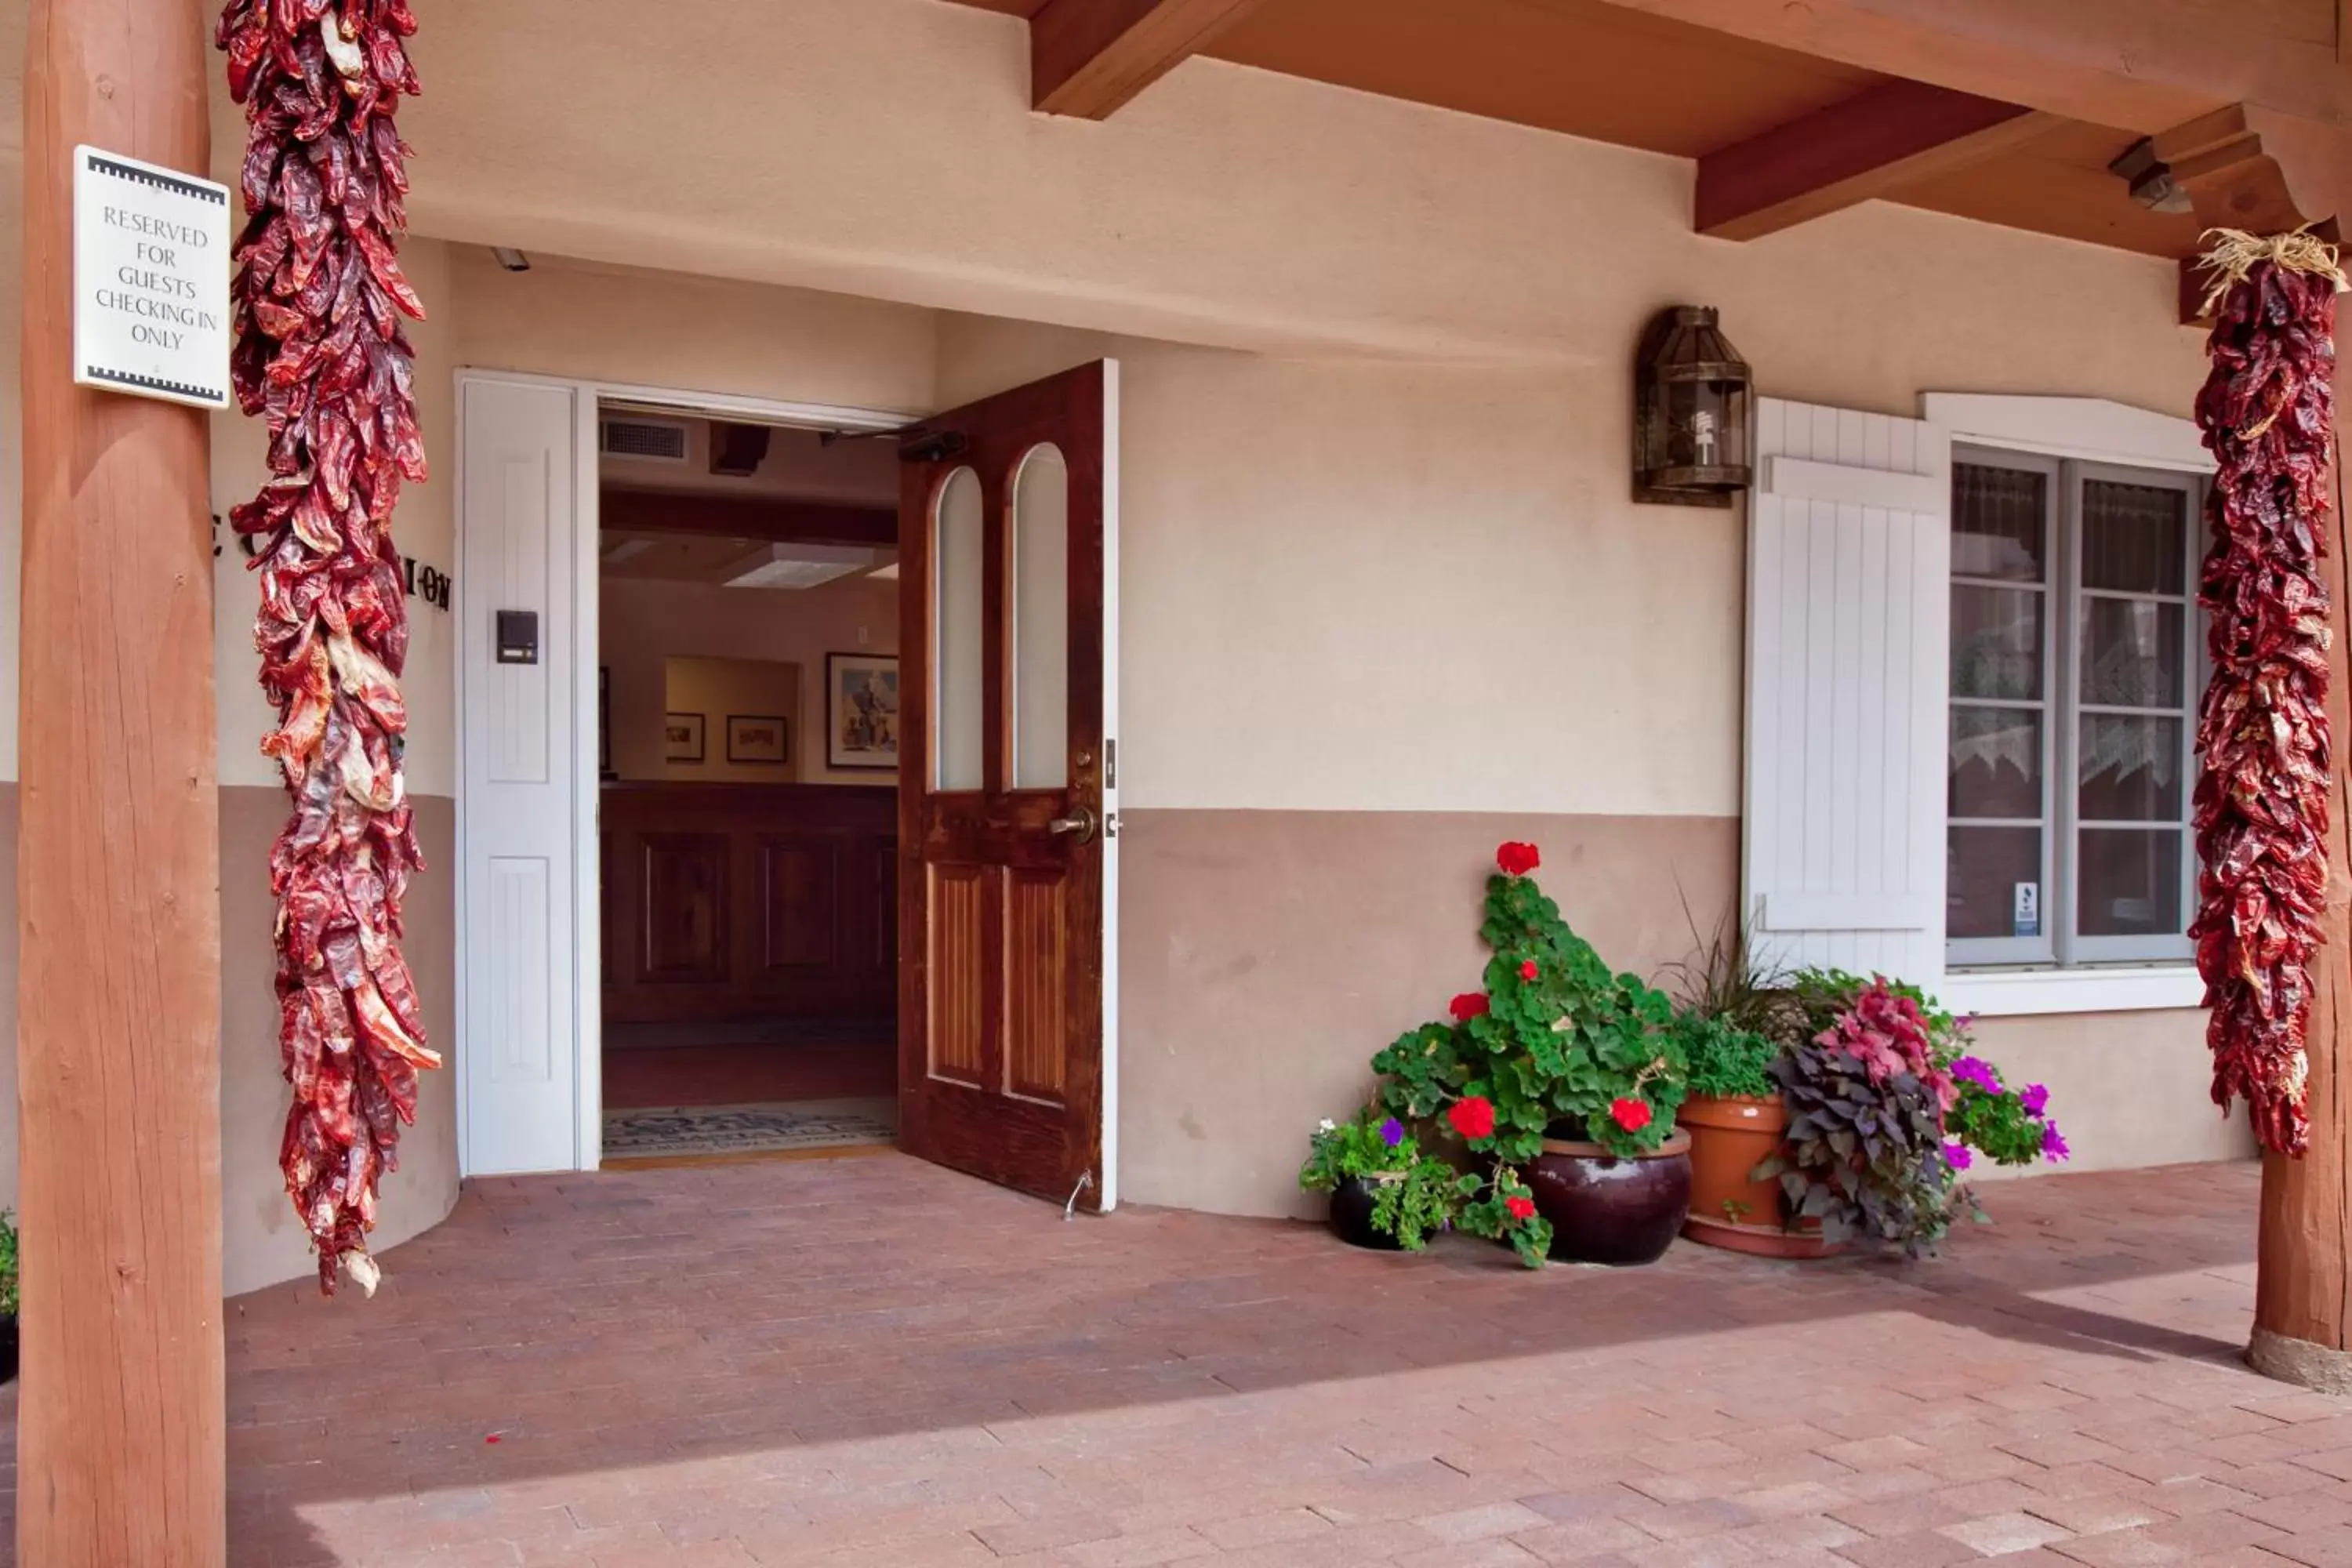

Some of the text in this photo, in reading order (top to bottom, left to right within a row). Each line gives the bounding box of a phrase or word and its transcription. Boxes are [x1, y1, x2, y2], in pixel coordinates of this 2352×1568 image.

[103, 205, 208, 251] RESERVED
[137, 242, 176, 268] FOR
[118, 267, 196, 299] GUESTS
[96, 289, 216, 331] CHECKING IN
[132, 324, 183, 350] ONLY
